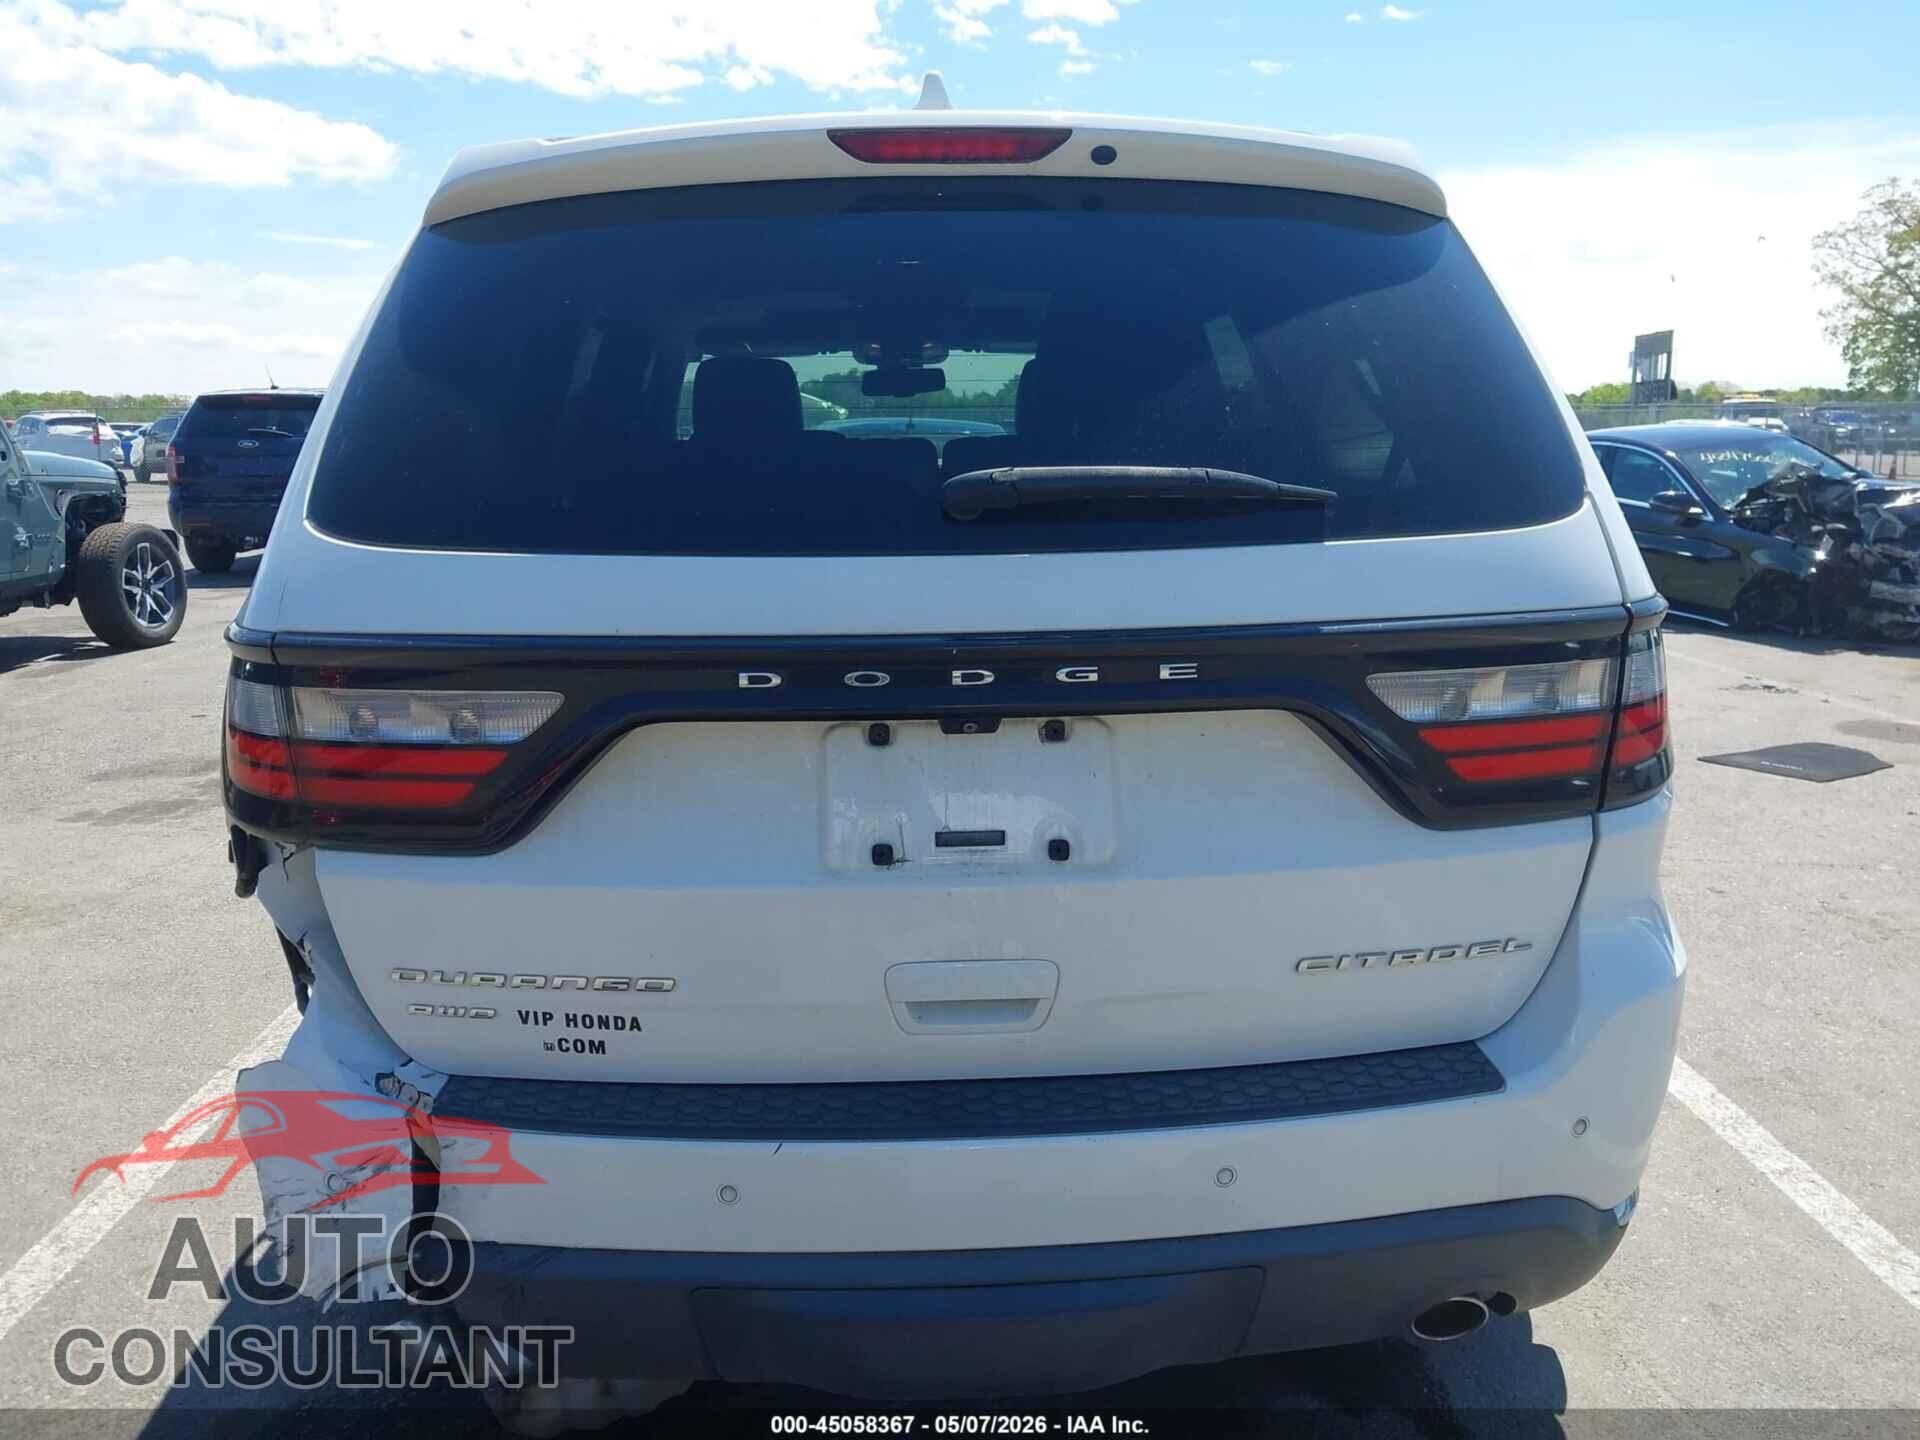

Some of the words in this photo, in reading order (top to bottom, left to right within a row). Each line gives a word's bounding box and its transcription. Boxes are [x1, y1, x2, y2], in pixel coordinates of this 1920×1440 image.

[738, 663, 1199, 688] DODGE
[1295, 937, 1532, 974] CITADEL
[391, 967, 677, 993] DURANGO
[407, 1003, 497, 1019] AWD
[516, 1009, 554, 1027] VIP
[565, 1012, 643, 1033] HONDA
[557, 1037, 607, 1055] COM
